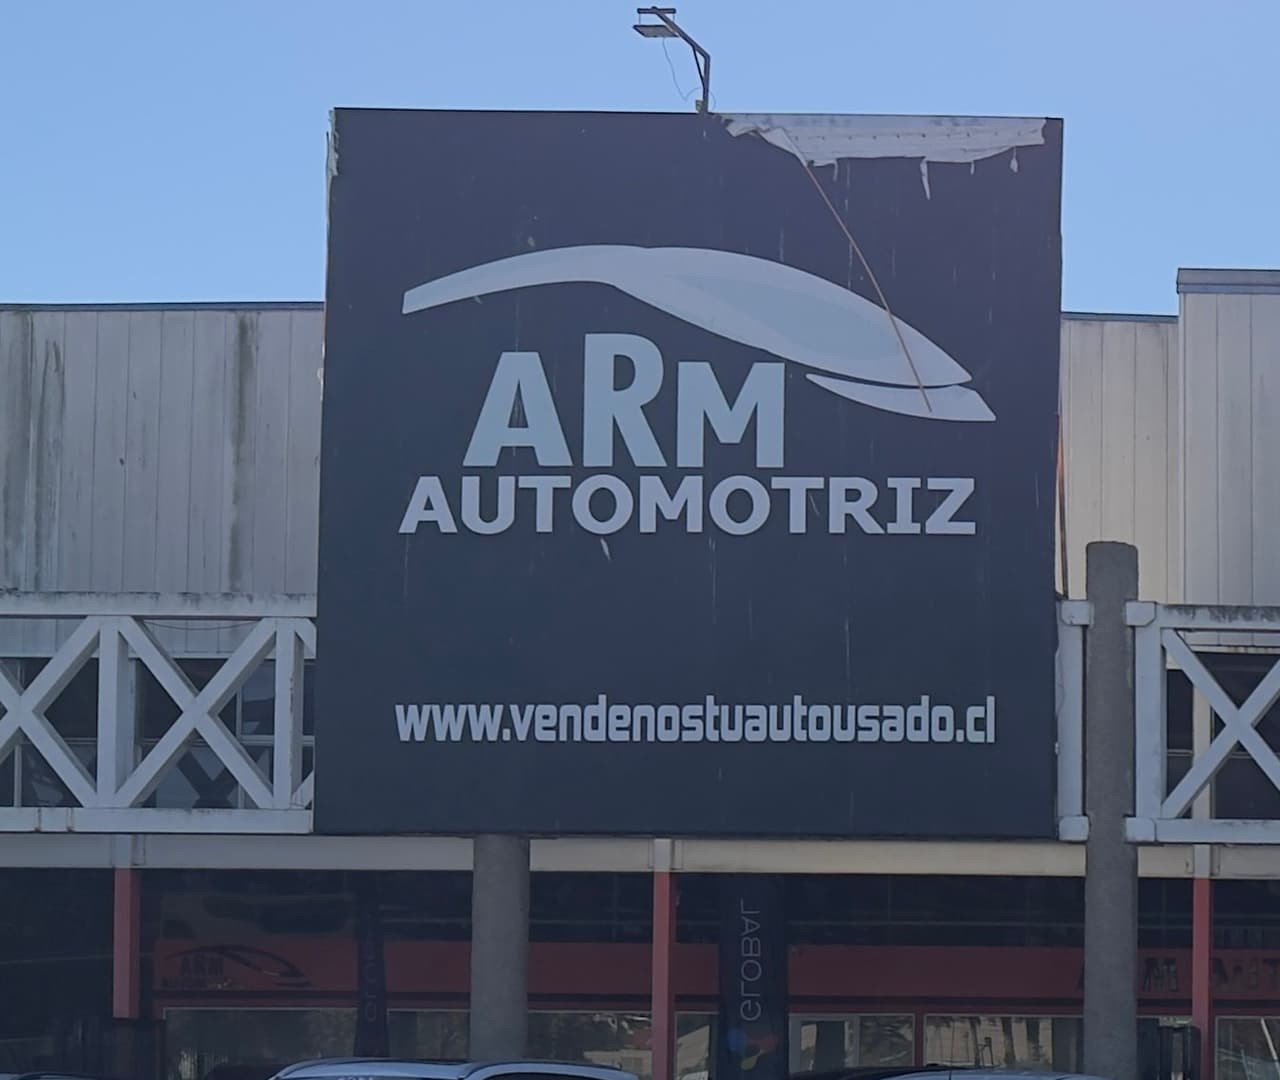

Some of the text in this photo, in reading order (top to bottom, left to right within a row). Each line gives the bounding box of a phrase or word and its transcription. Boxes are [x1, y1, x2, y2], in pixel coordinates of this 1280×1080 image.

[462, 333, 786, 468] ARM
[398, 474, 977, 536] AUTOMOTRIZ
[395, 694, 996, 744] www.vendenostuautousado.cl
